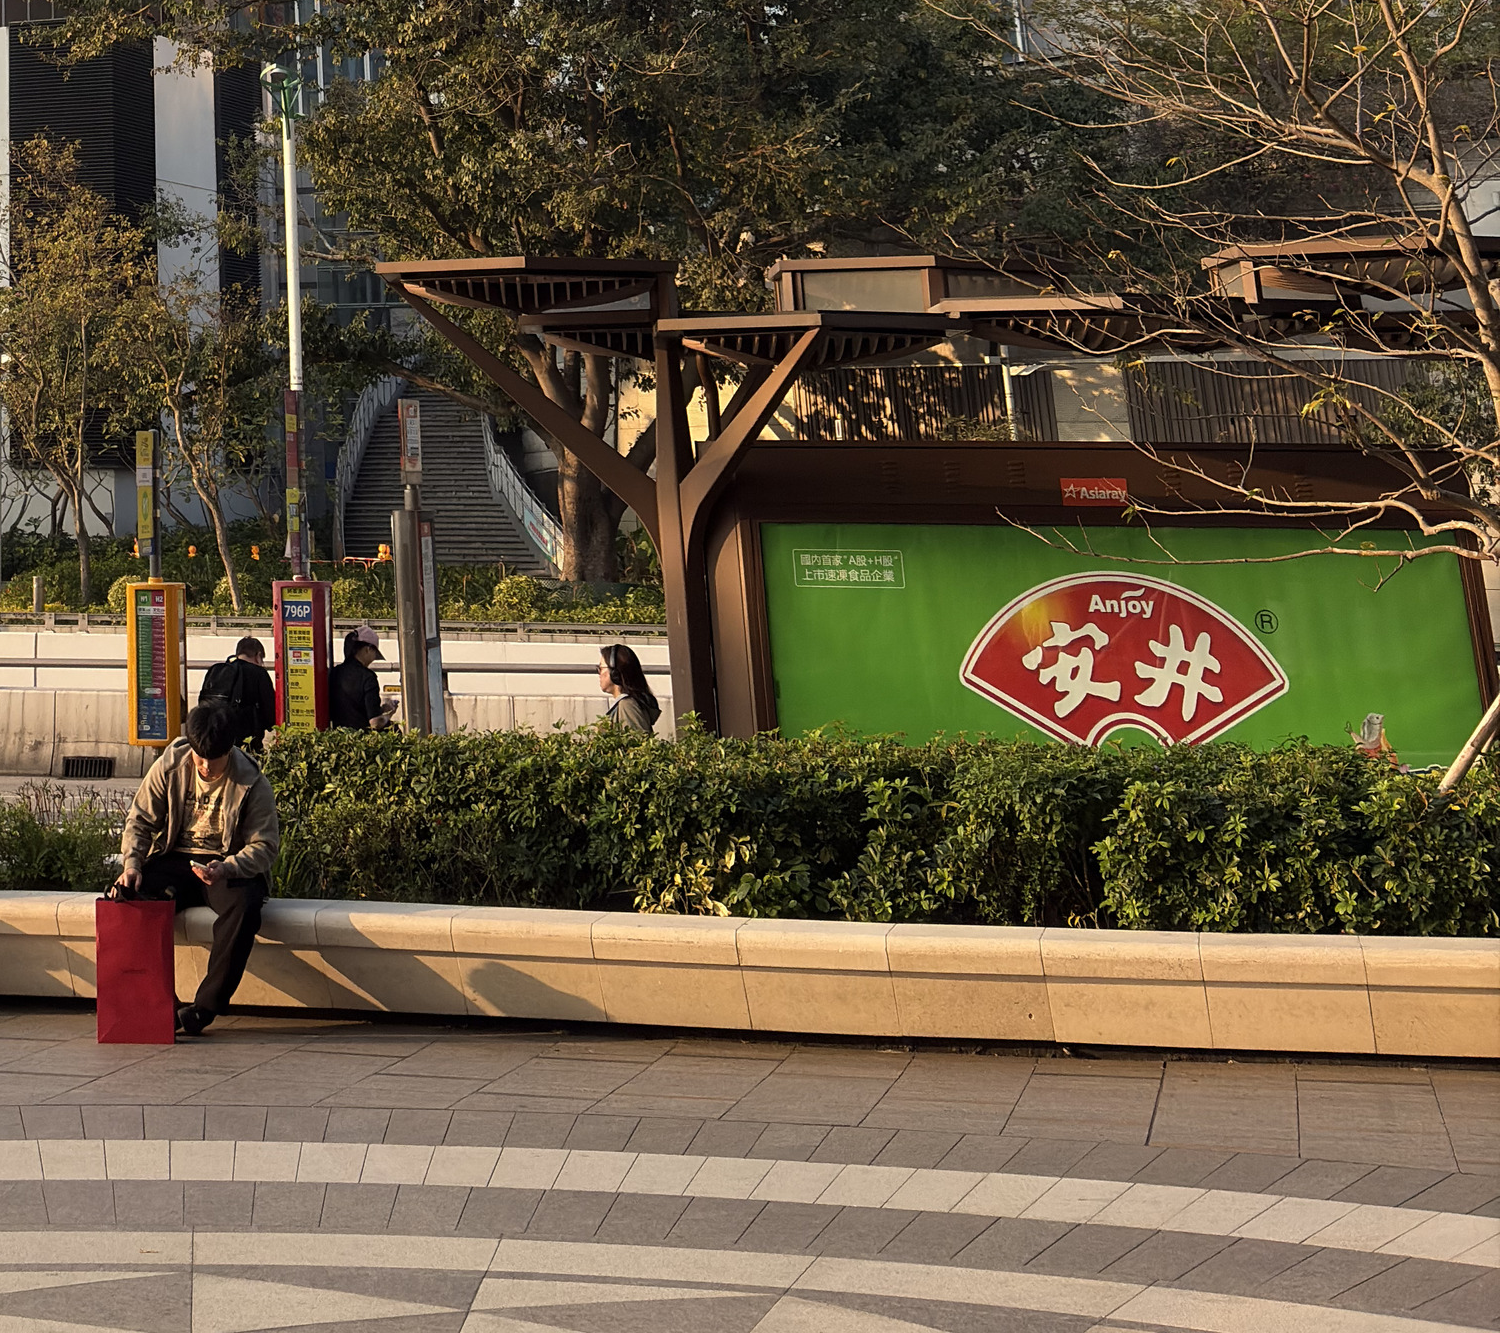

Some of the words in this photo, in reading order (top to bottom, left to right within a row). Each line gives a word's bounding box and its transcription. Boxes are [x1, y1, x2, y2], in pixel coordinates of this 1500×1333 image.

[1080, 486, 1127, 502] Asiaray
[802, 569, 895, 582] 上市速凍食品企業
[284, 604, 311, 618] 796P
[1088, 589, 1154, 618] Anjoy
[1022, 622, 1224, 722] 安井
